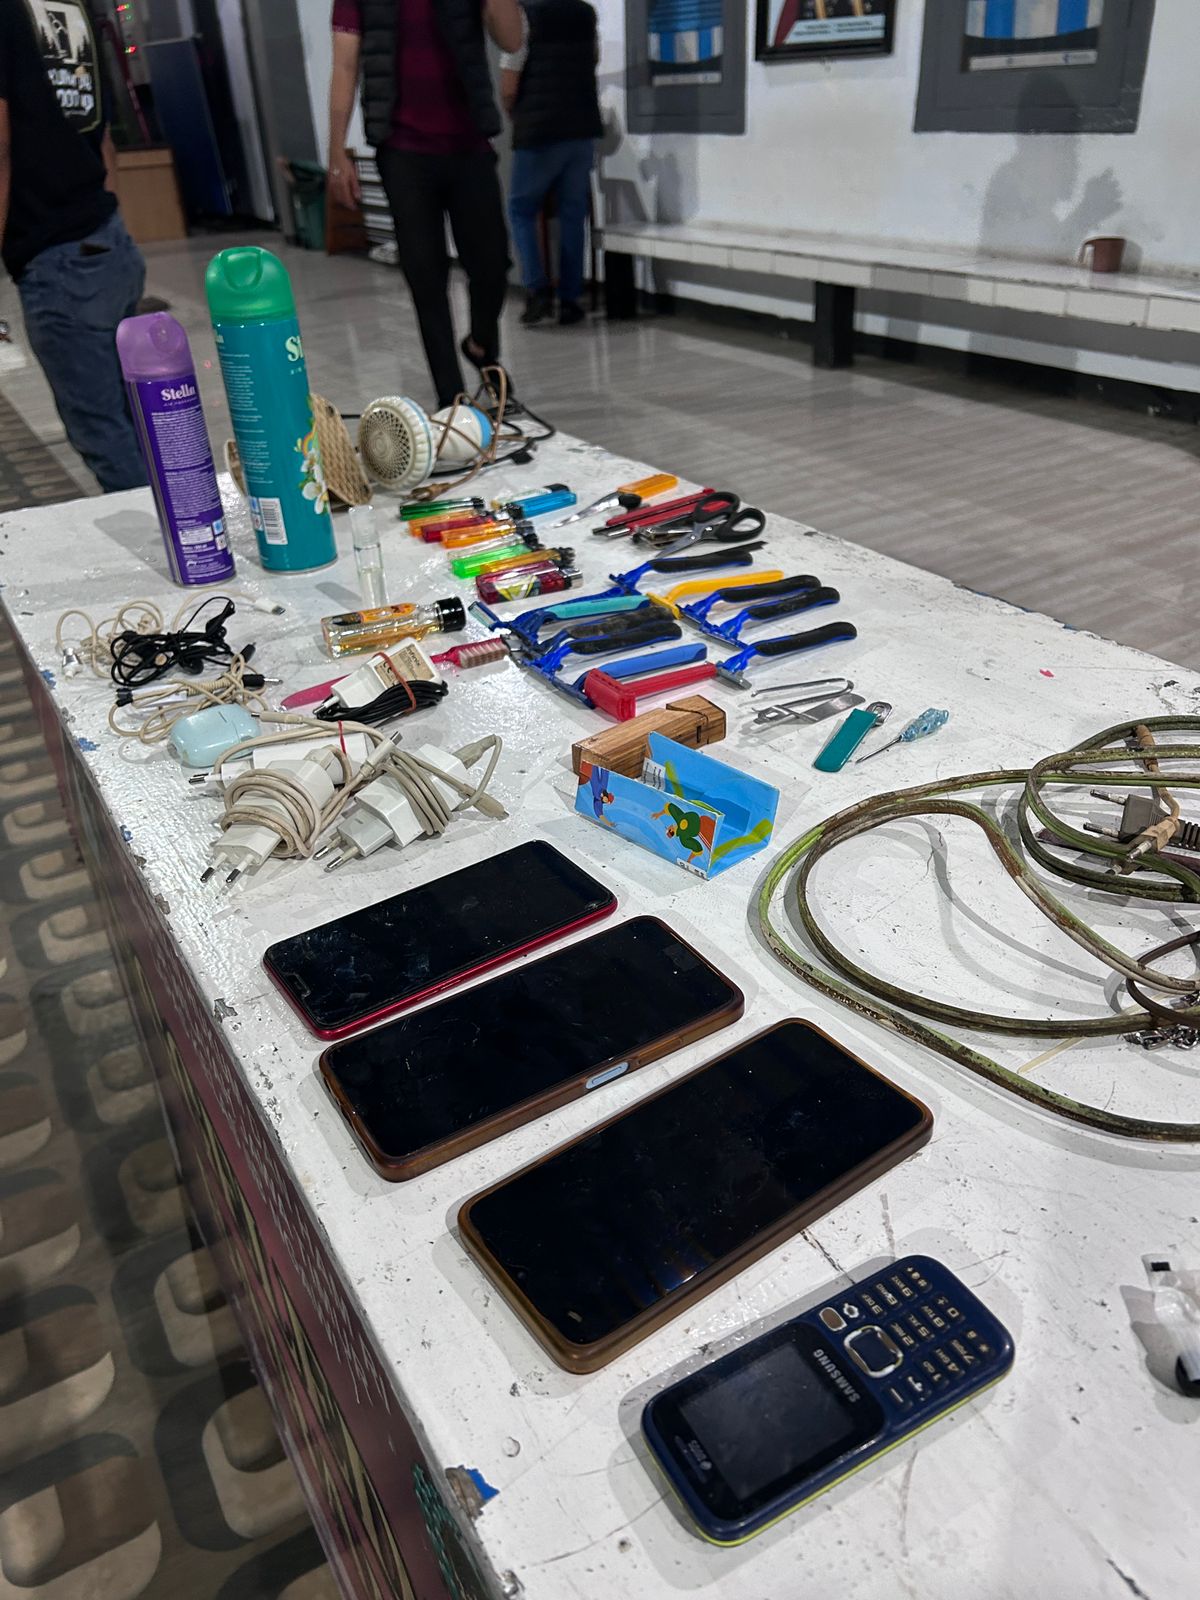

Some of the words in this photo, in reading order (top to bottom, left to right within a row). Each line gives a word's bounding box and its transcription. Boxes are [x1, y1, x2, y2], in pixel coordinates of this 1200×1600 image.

[160, 383, 197, 401] Stella
[901, 1286, 913, 1297] 9
[871, 1304, 883, 1315] 3
[932, 1316, 945, 1328] 8
[917, 1326, 930, 1337] 5
[902, 1335, 915, 1346] 2
[813, 1348, 861, 1403] SAMSUNG
